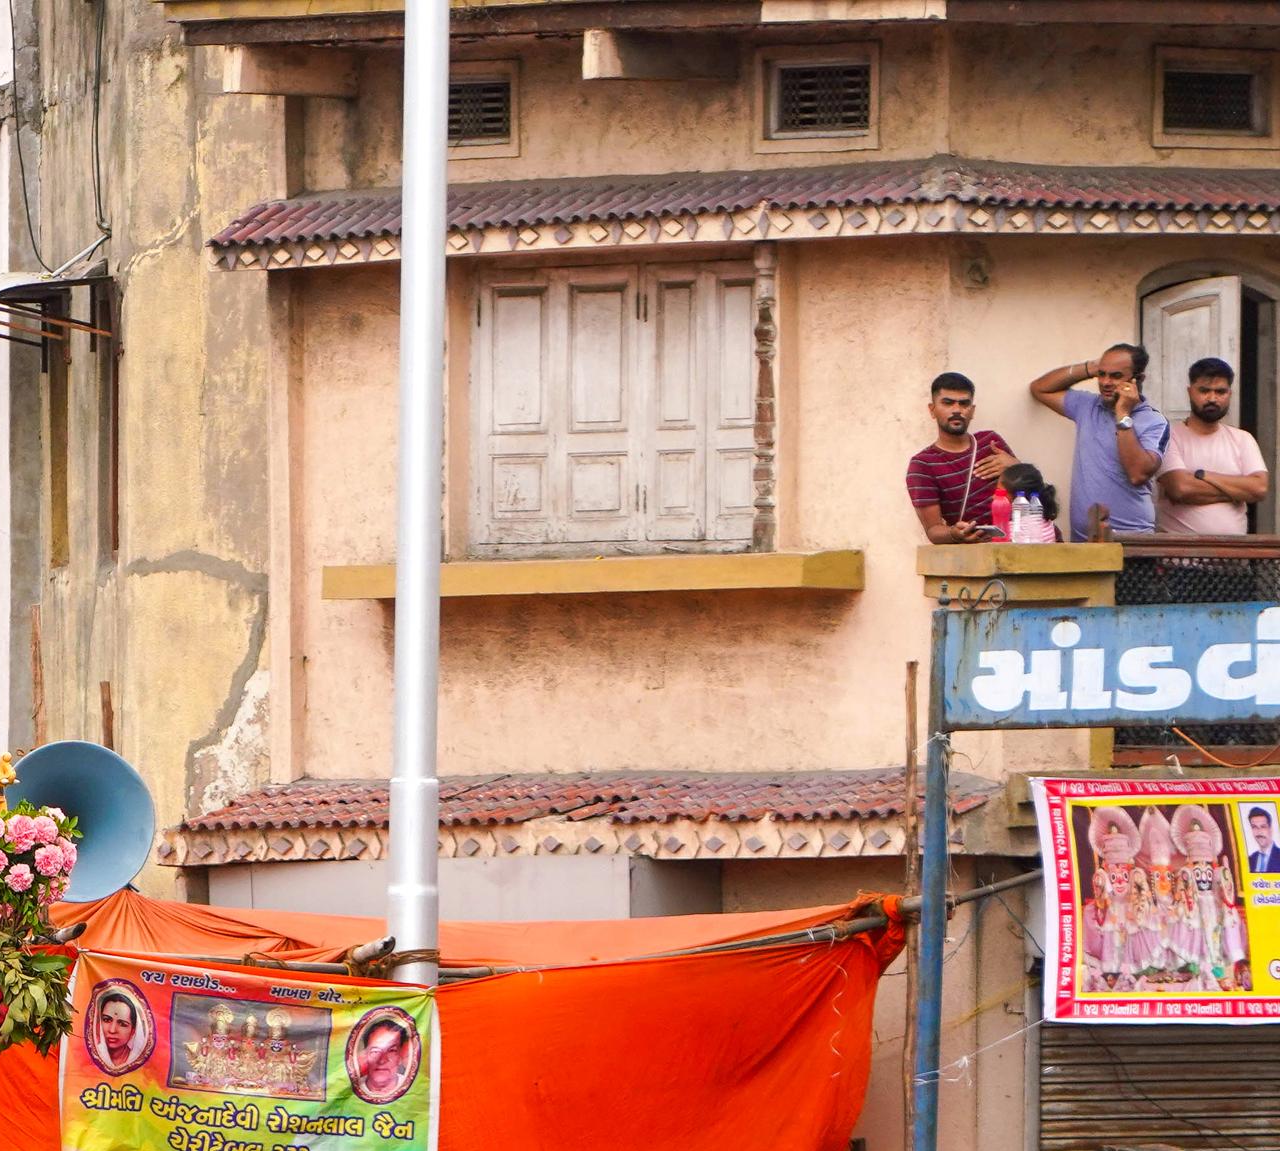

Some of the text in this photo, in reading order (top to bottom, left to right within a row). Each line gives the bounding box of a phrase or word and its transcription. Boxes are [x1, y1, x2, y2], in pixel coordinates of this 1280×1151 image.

[140, 970, 165, 985] જય
[269, 986, 312, 1001] માખણ
[80, 1082, 415, 1140] શ્રીમતિ અંજનાદેવી રોશનલાલ જૈન
